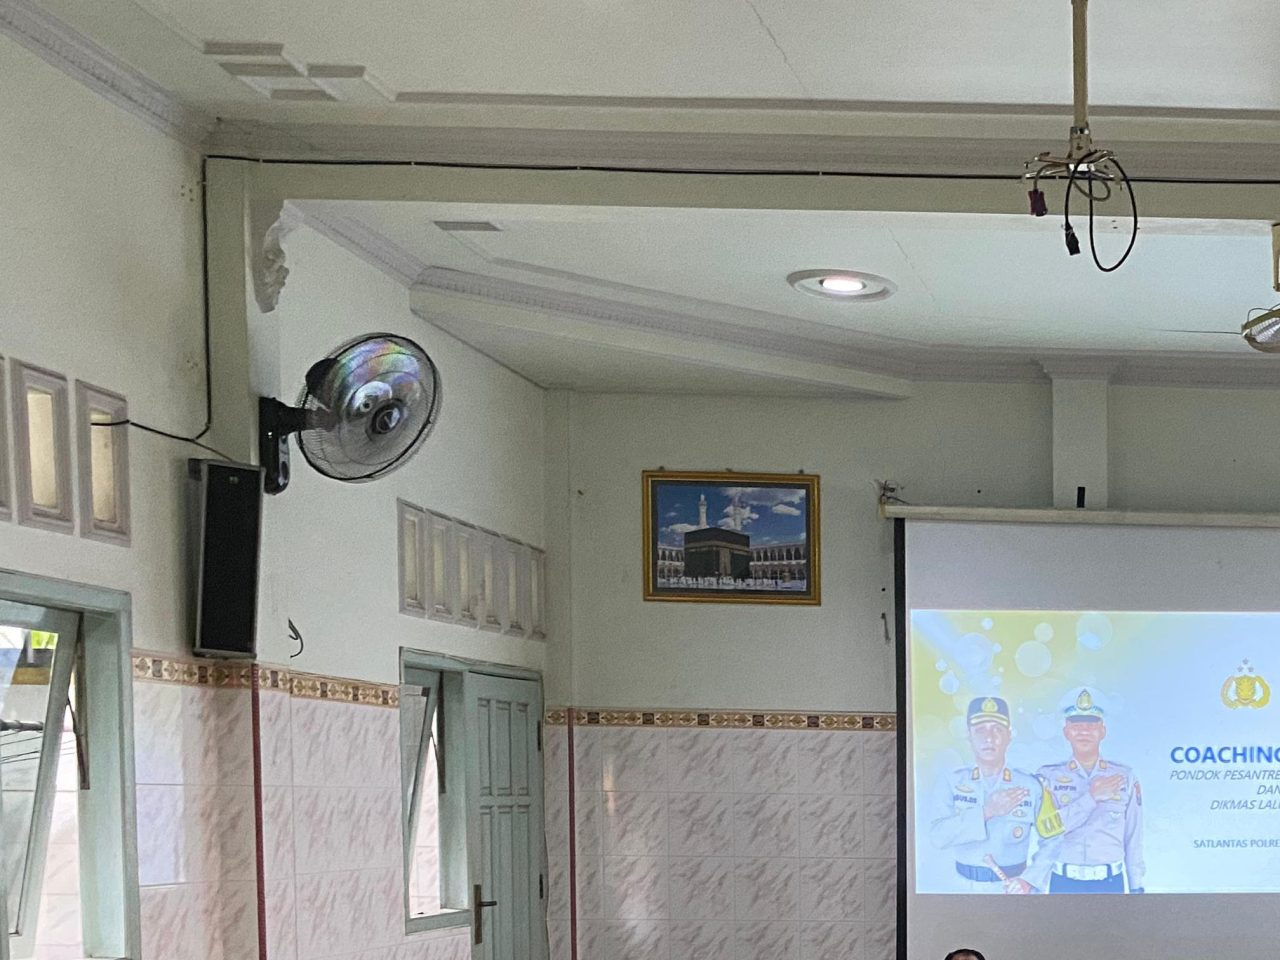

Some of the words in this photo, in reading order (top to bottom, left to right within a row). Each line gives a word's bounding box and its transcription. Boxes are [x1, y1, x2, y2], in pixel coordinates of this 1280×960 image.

[1169, 769, 1222, 781] PONDOK
[1209, 799, 1257, 810] DIKMAS
[1193, 839, 1248, 848] SATLANTAS
